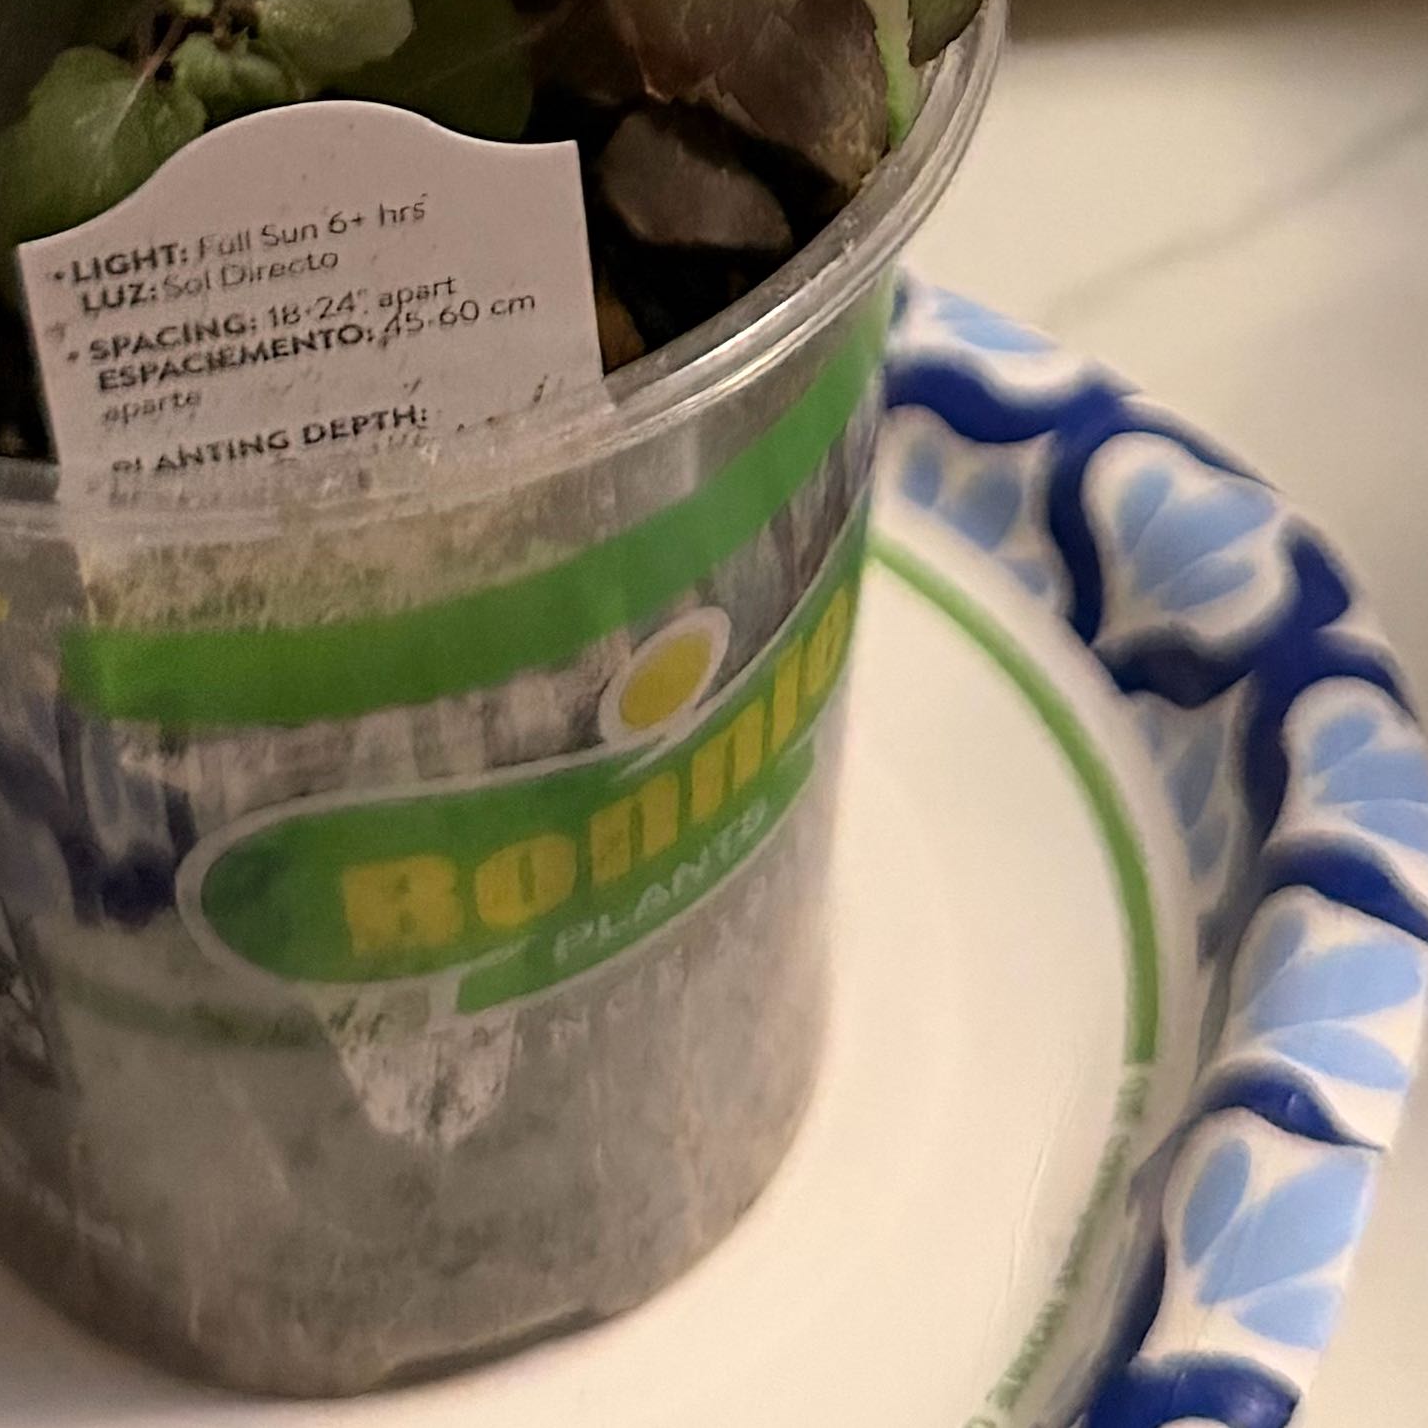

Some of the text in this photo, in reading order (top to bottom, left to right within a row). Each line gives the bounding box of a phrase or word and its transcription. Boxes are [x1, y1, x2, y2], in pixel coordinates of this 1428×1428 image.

[72, 202, 426, 283] LIGHT: Full Sun 6+ hrs
[81, 252, 338, 312] LUZ: Sol Directo
[89, 312, 257, 361] SPACING:
[378, 275, 456, 315] apart
[98, 323, 373, 391] ESPACIEMENTO:
[490, 294, 535, 317] cm
[104, 392, 202, 427] aparte
[302, 405, 428, 445] DEPTH:
[340, 586, 850, 955] Bonnie
